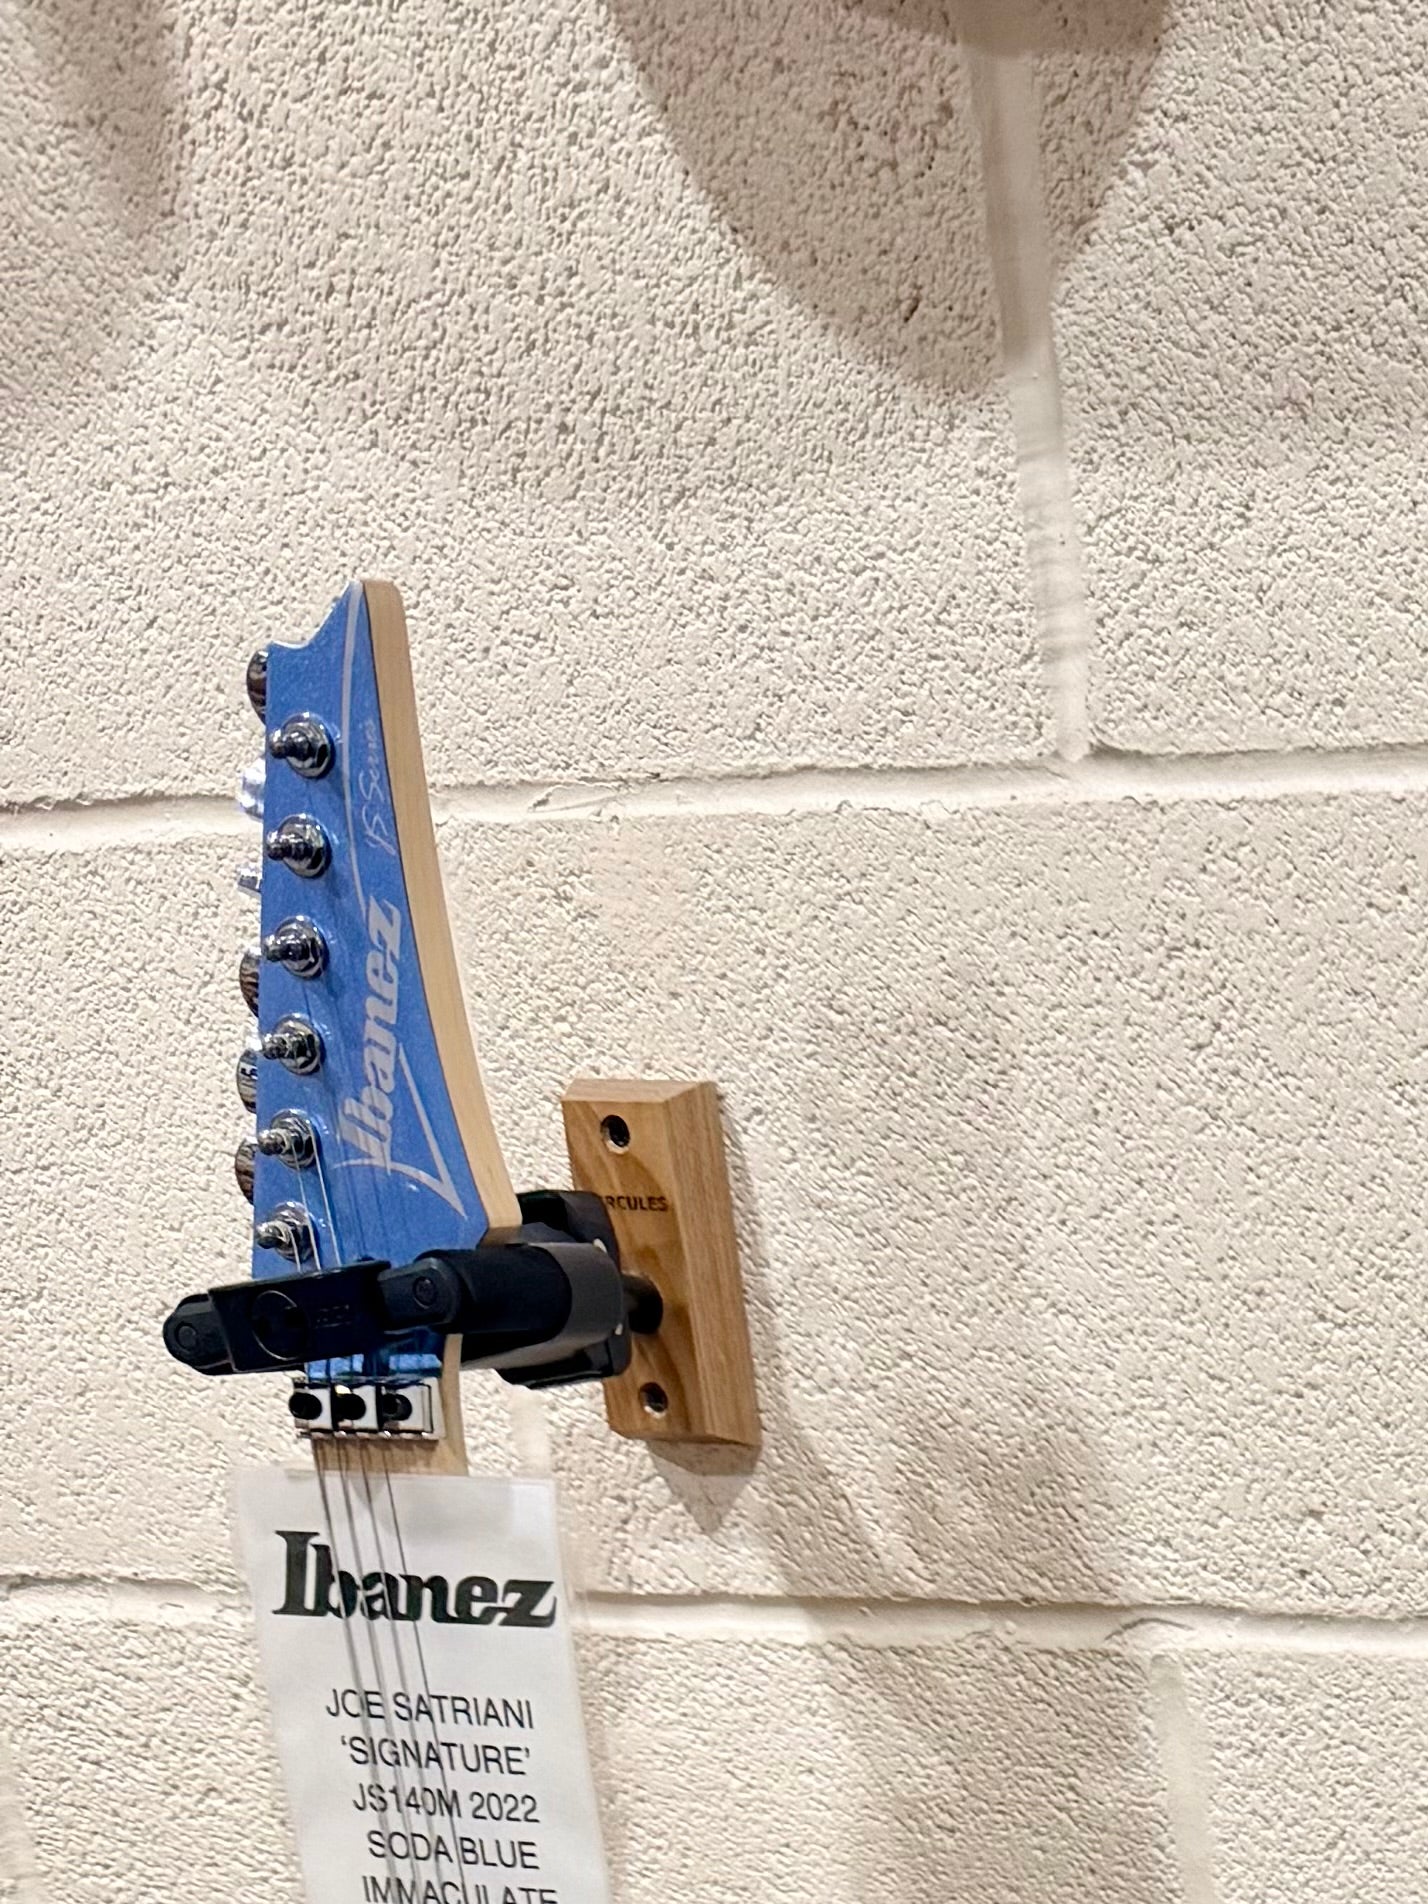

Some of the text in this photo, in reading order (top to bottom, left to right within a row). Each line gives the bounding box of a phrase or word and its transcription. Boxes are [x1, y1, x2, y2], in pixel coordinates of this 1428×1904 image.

[338, 895, 402, 1176] Ibanez
[604, 1195, 669, 1212] RCULES
[272, 1530, 557, 1629] Ibanez
[326, 1688, 535, 1729] JOE SATRIANI
[352, 1782, 541, 1824] JS140M 2022
[366, 1829, 541, 1871] SODA BLUE
